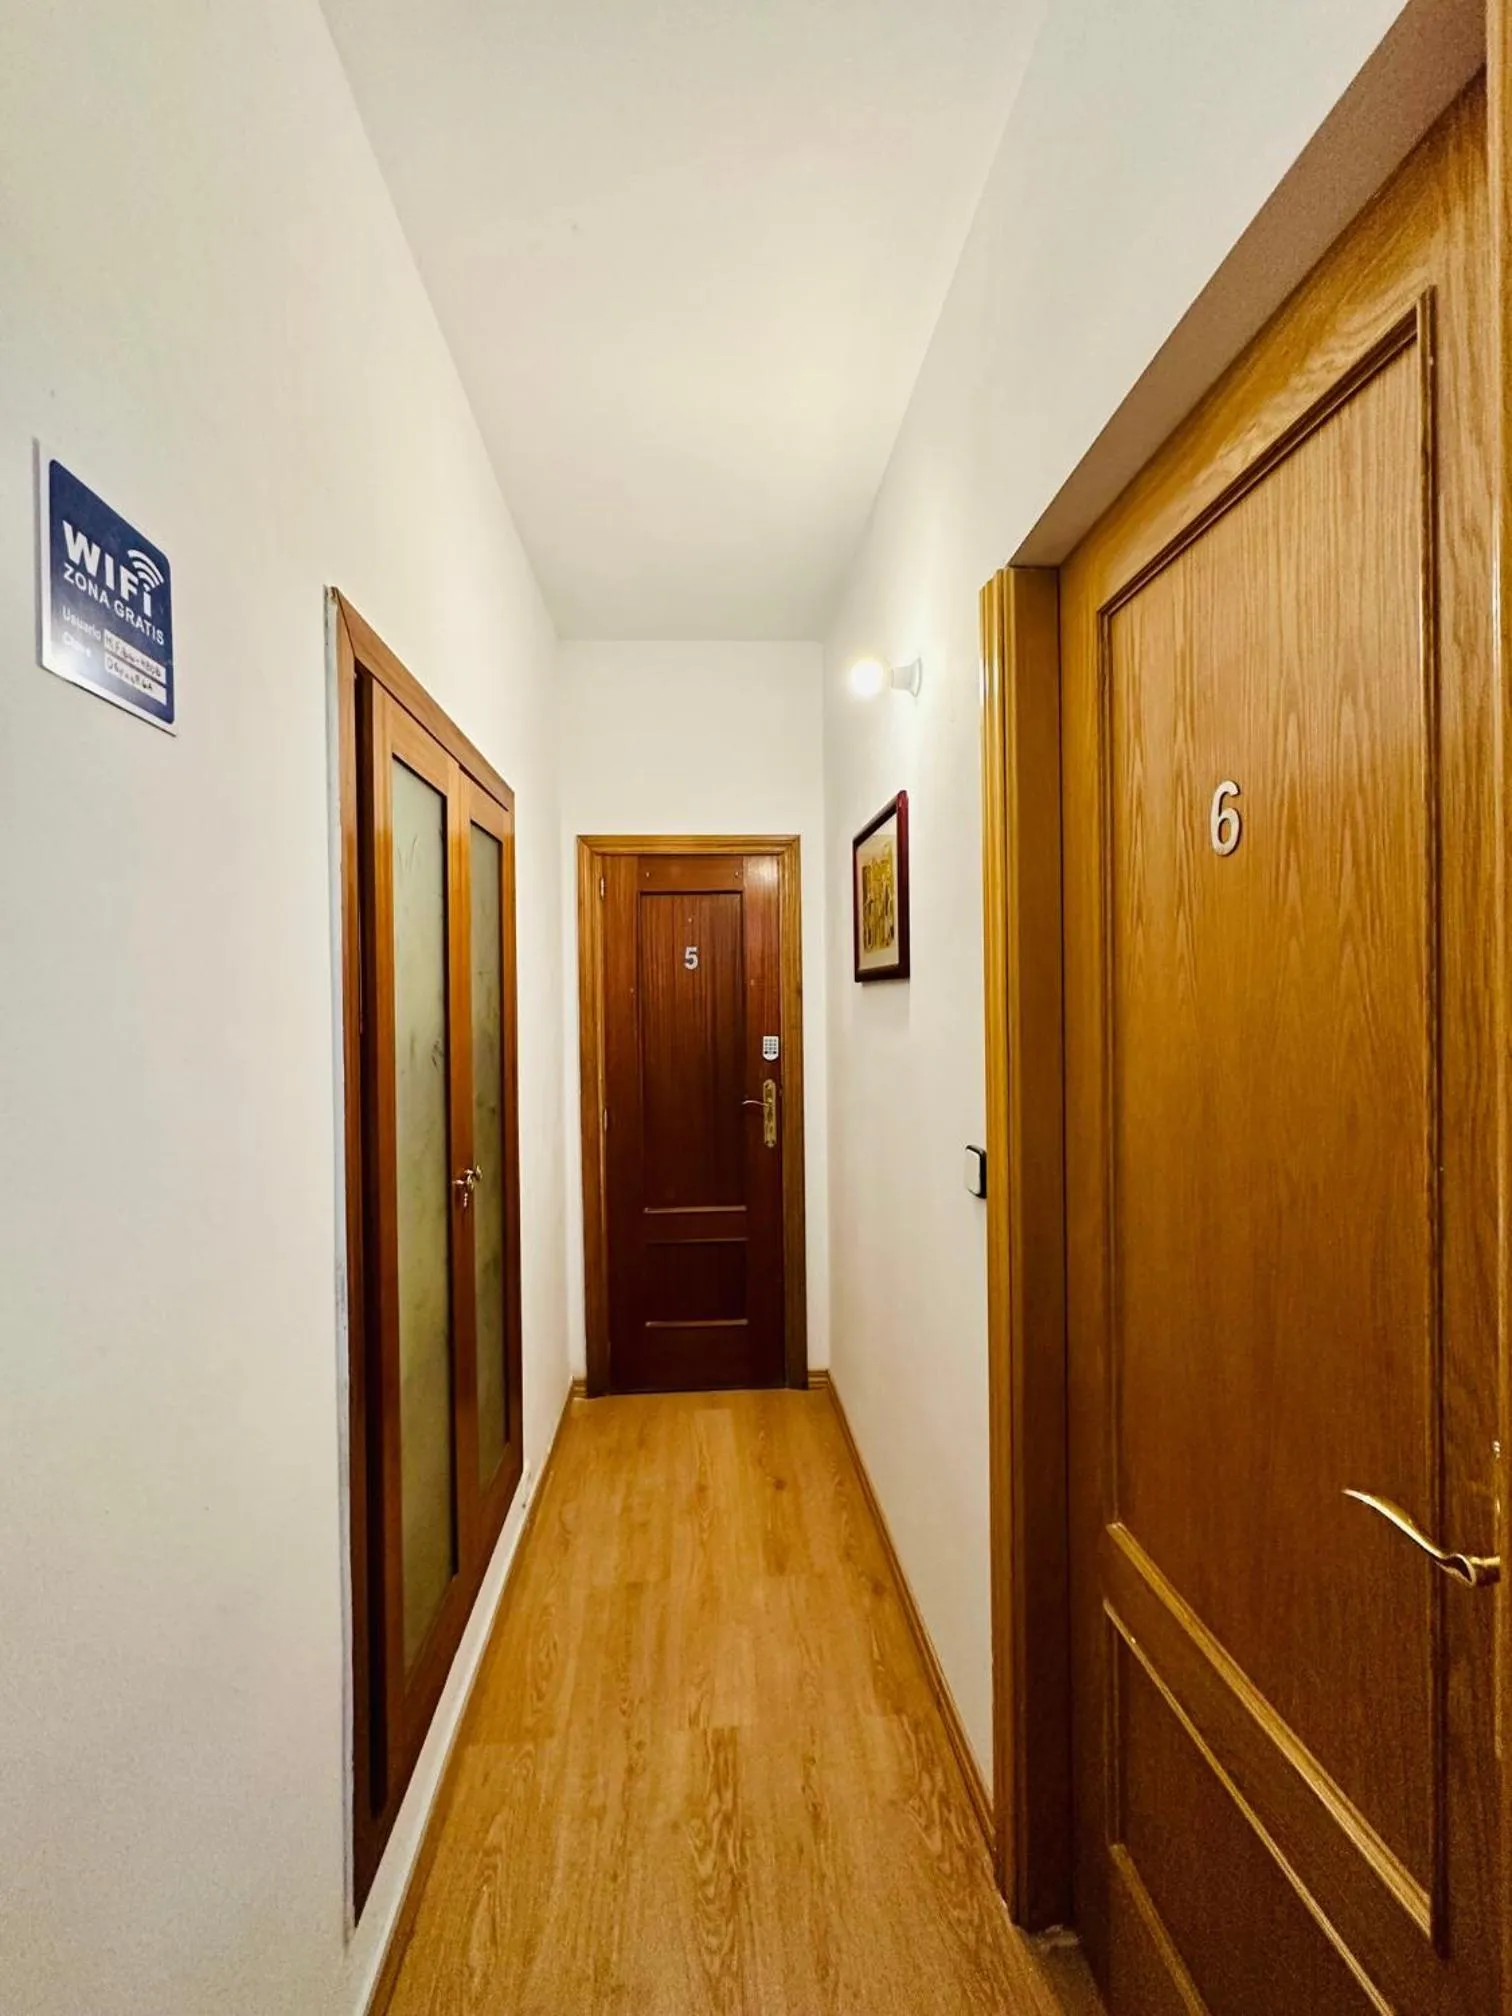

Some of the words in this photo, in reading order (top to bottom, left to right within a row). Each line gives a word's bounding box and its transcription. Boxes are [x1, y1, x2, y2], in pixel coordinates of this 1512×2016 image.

[63, 562, 110, 609] ZONA
[114, 600, 165, 646] GRATIS
[1211, 780, 1242, 857] 6
[684, 946, 698, 970] 5
